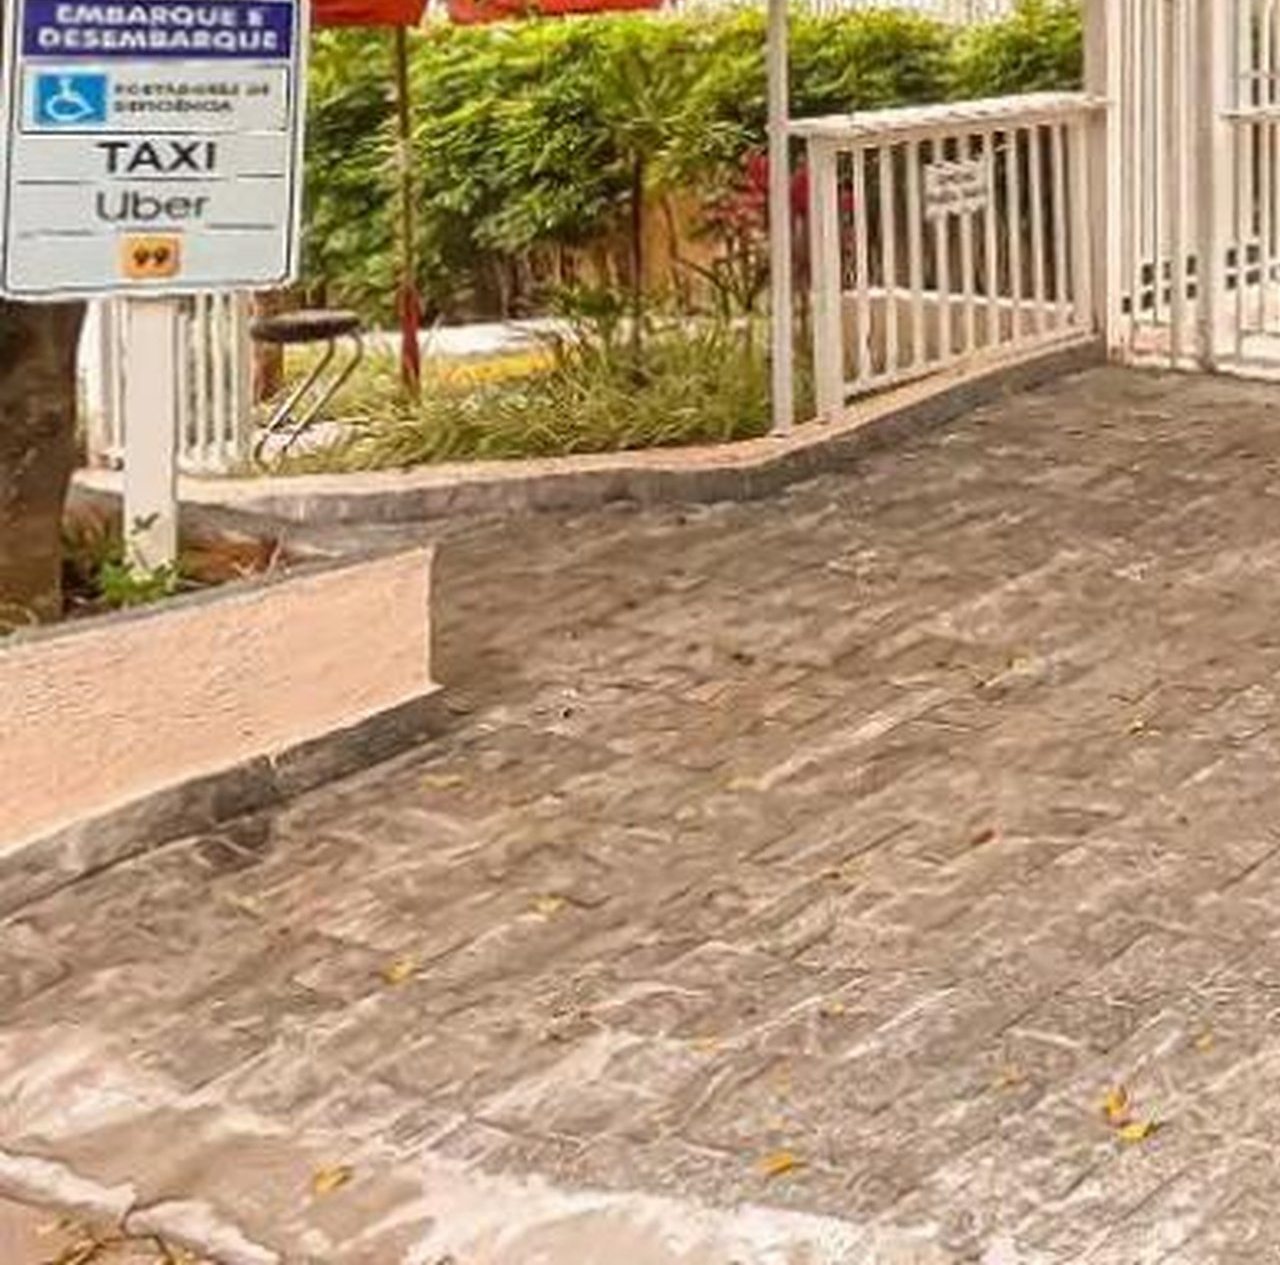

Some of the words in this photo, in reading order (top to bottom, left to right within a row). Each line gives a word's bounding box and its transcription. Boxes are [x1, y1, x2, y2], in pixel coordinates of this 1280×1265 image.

[56, 3, 237, 27] EMBARQUE
[247, 10, 264, 26] E
[38, 28, 278, 51] DESEMBARQUE
[96, 141, 217, 173] TAXI
[96, 190, 210, 221] Uber
